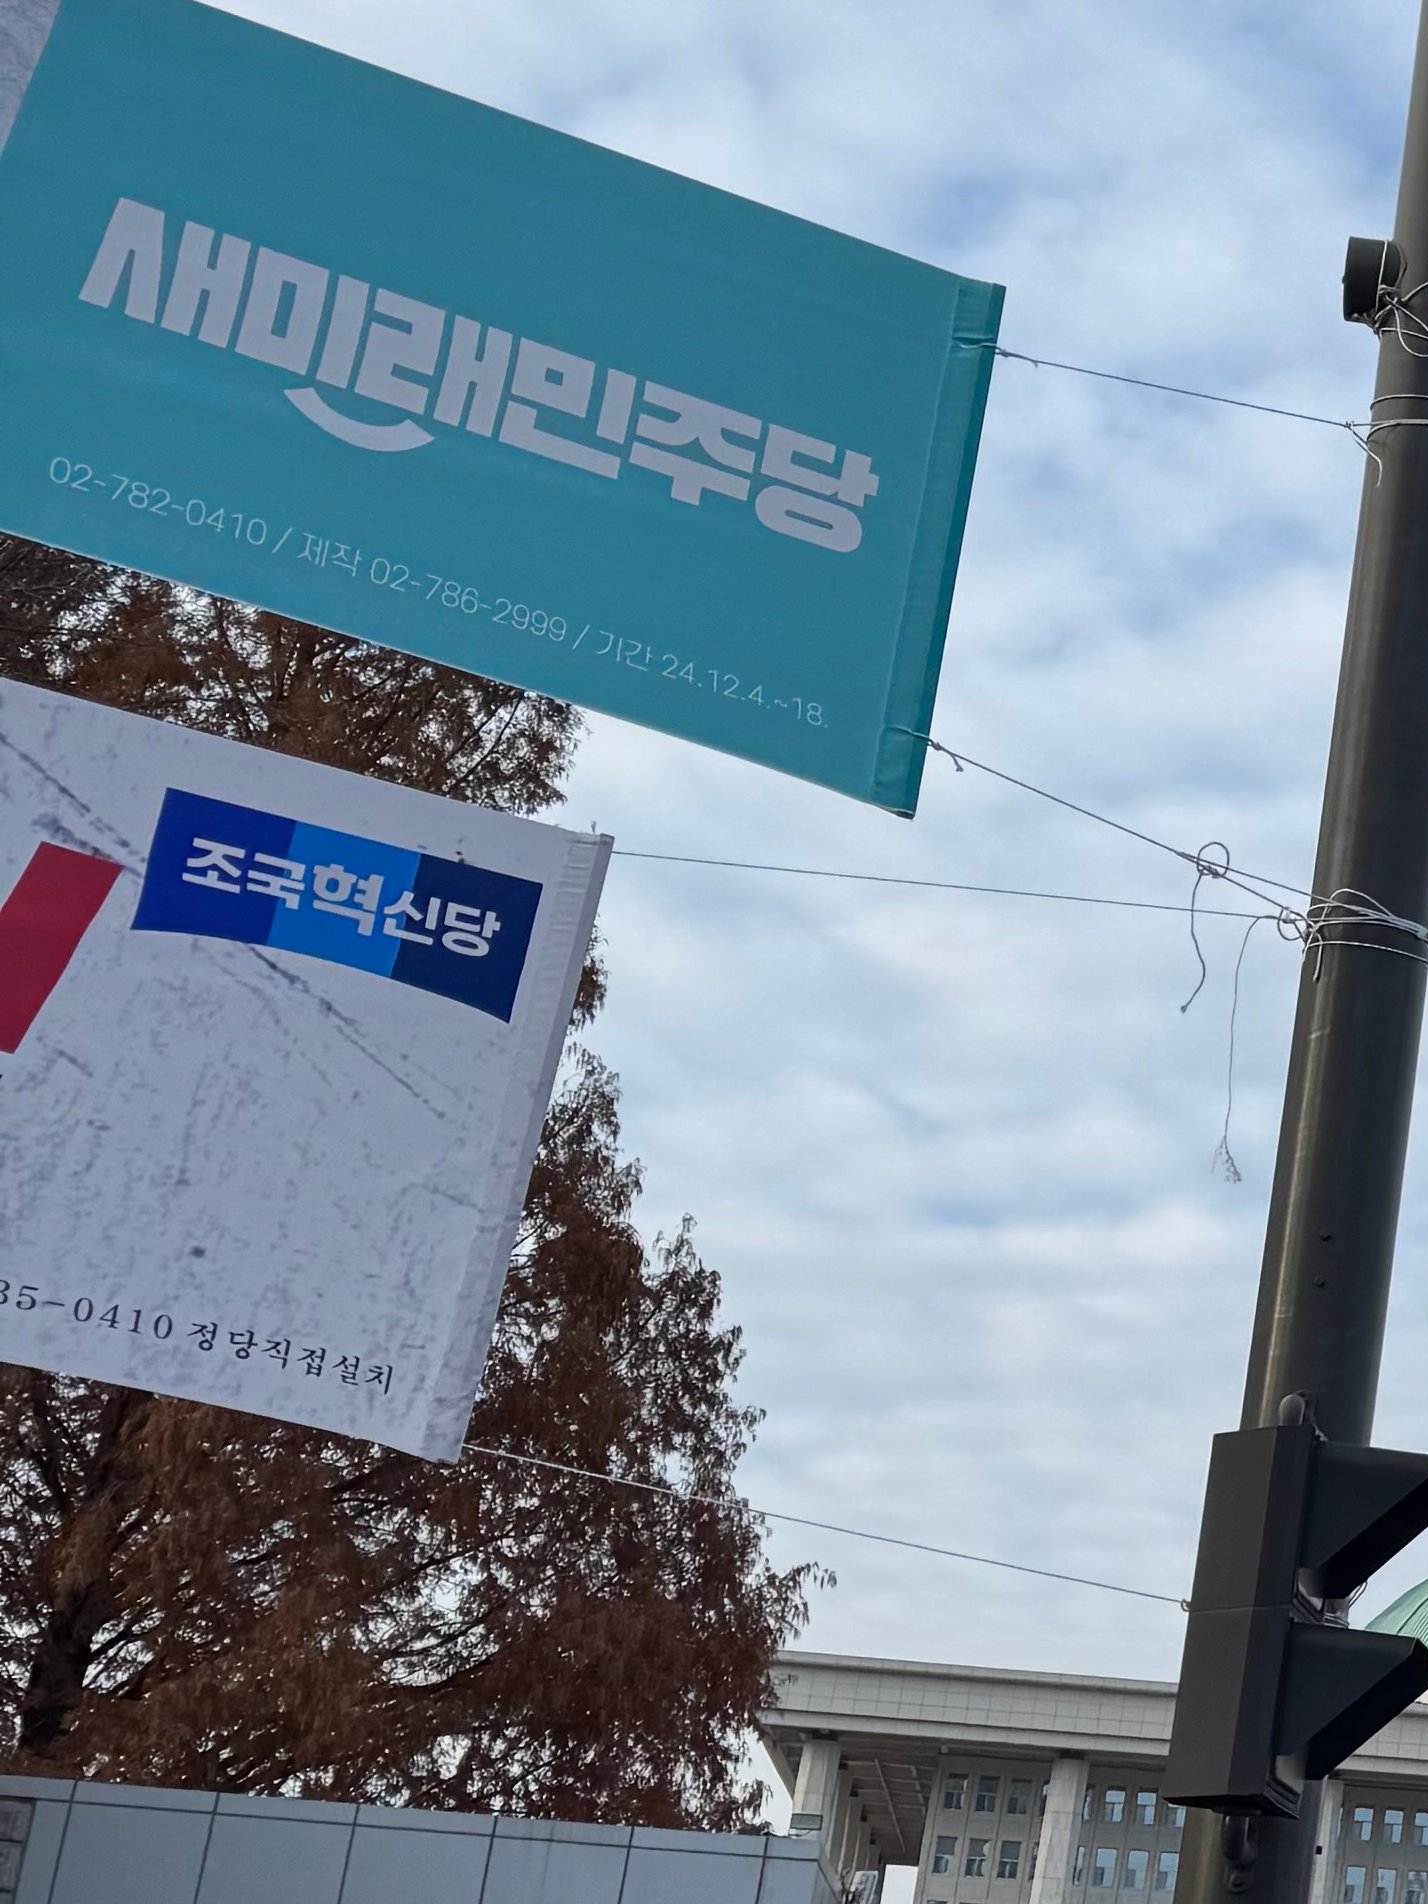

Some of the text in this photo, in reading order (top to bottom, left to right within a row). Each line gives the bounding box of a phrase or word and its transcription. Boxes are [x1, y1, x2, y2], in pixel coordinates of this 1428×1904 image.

[78, 196, 880, 554] 새미래민주당
[49, 456, 268, 546] 02-782-0410
[297, 531, 363, 578] 제작
[369, 556, 567, 642] 02-786-2999
[596, 630, 654, 673] 기간
[180, 836, 501, 959] 조국혁신당
[187, 1321, 396, 1395] 정당직접설치
